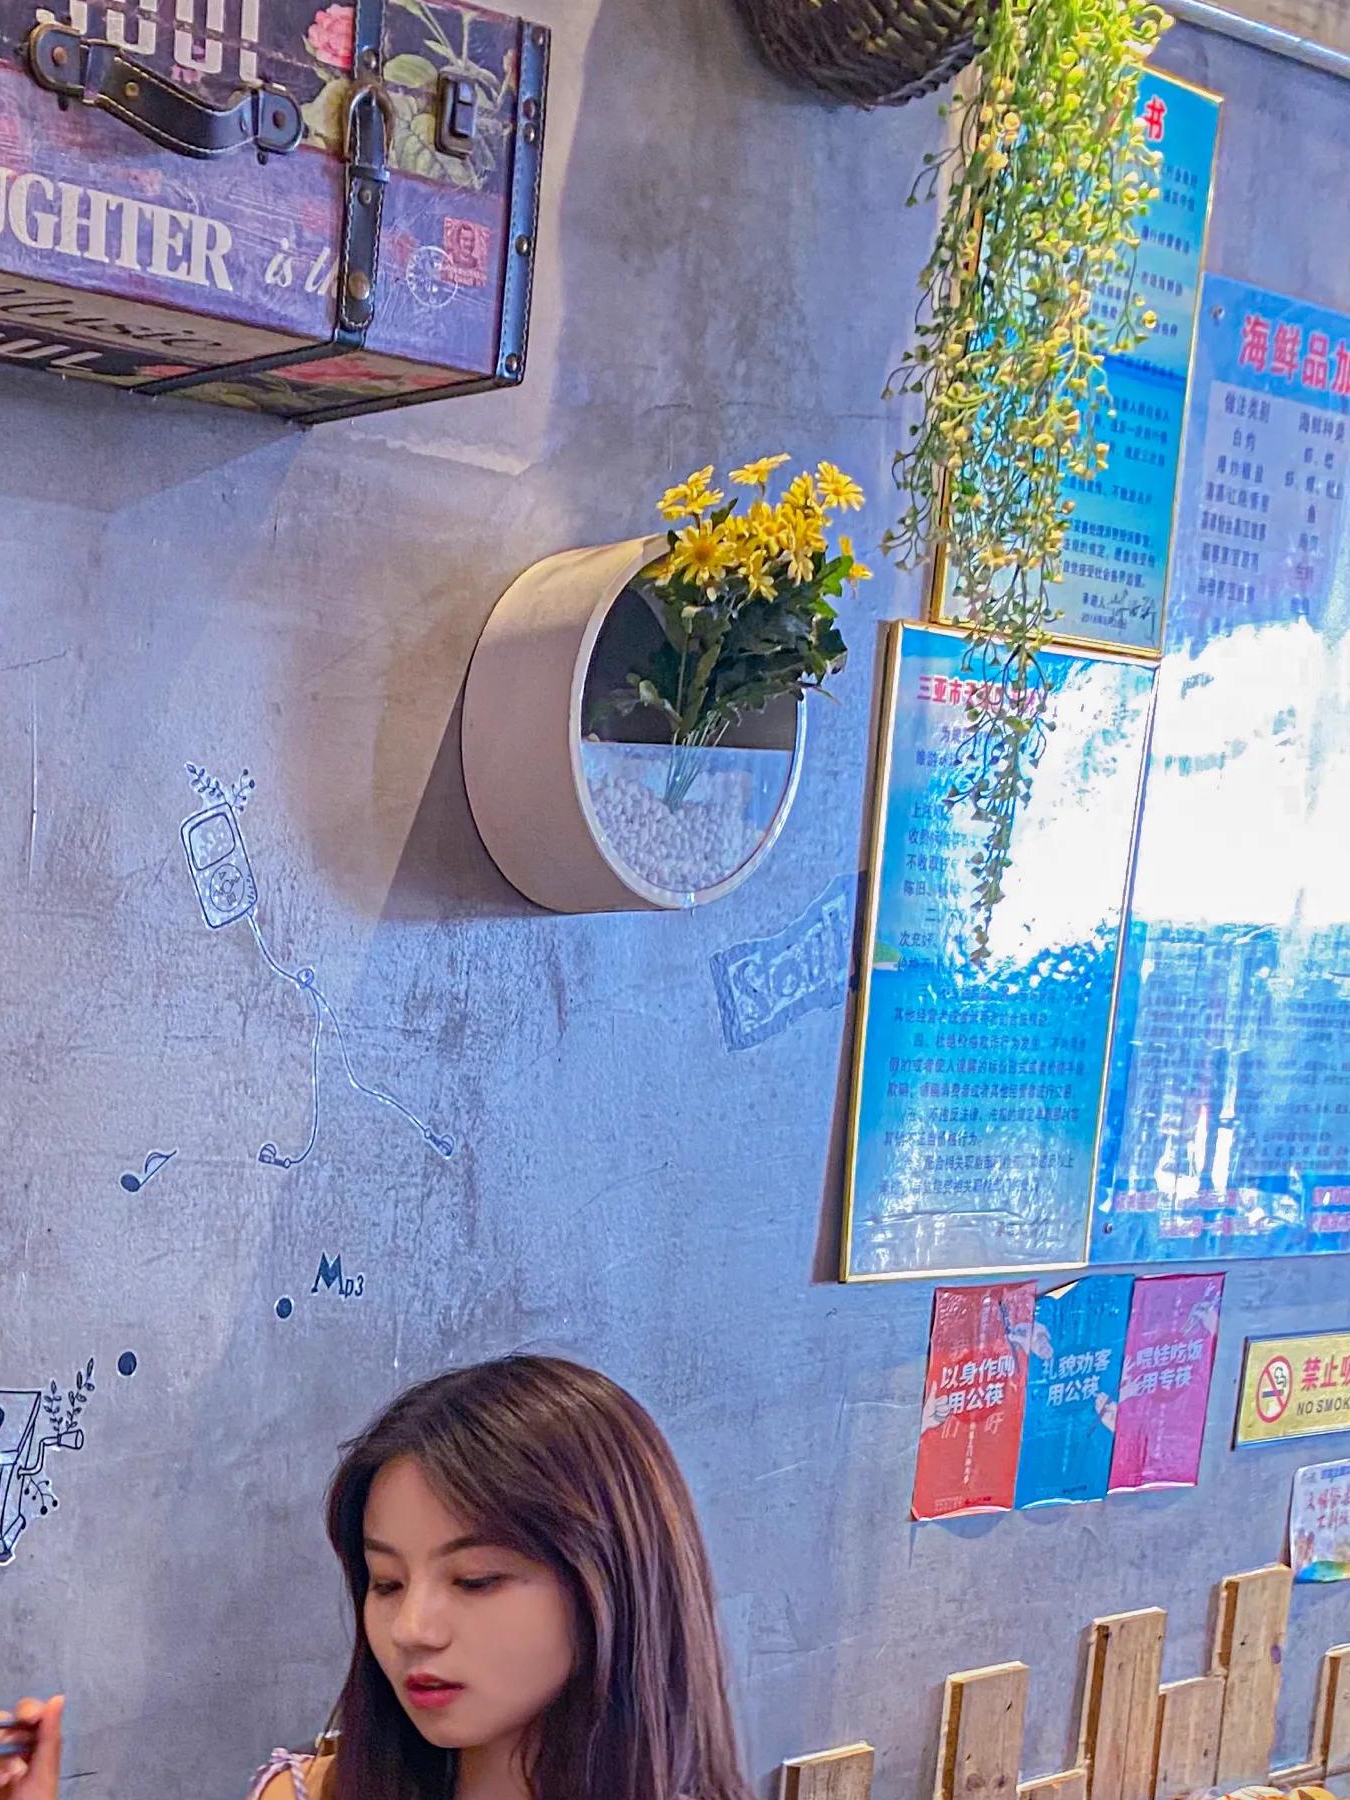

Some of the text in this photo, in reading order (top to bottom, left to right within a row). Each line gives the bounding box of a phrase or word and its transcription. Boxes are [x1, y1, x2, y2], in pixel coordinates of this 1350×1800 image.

[264, 237, 294, 288] is
[311, 1251, 364, 1299] Mp3
[1135, 1338, 1204, 1369] 喂娃吃饭
[940, 1354, 1015, 1389] 以身作则
[1138, 1366, 1193, 1396] 用专筷
[947, 1382, 1005, 1414] 用公筷
[1047, 1374, 1100, 1408] 用公筷
[1297, 1401, 1314, 1416] NO
